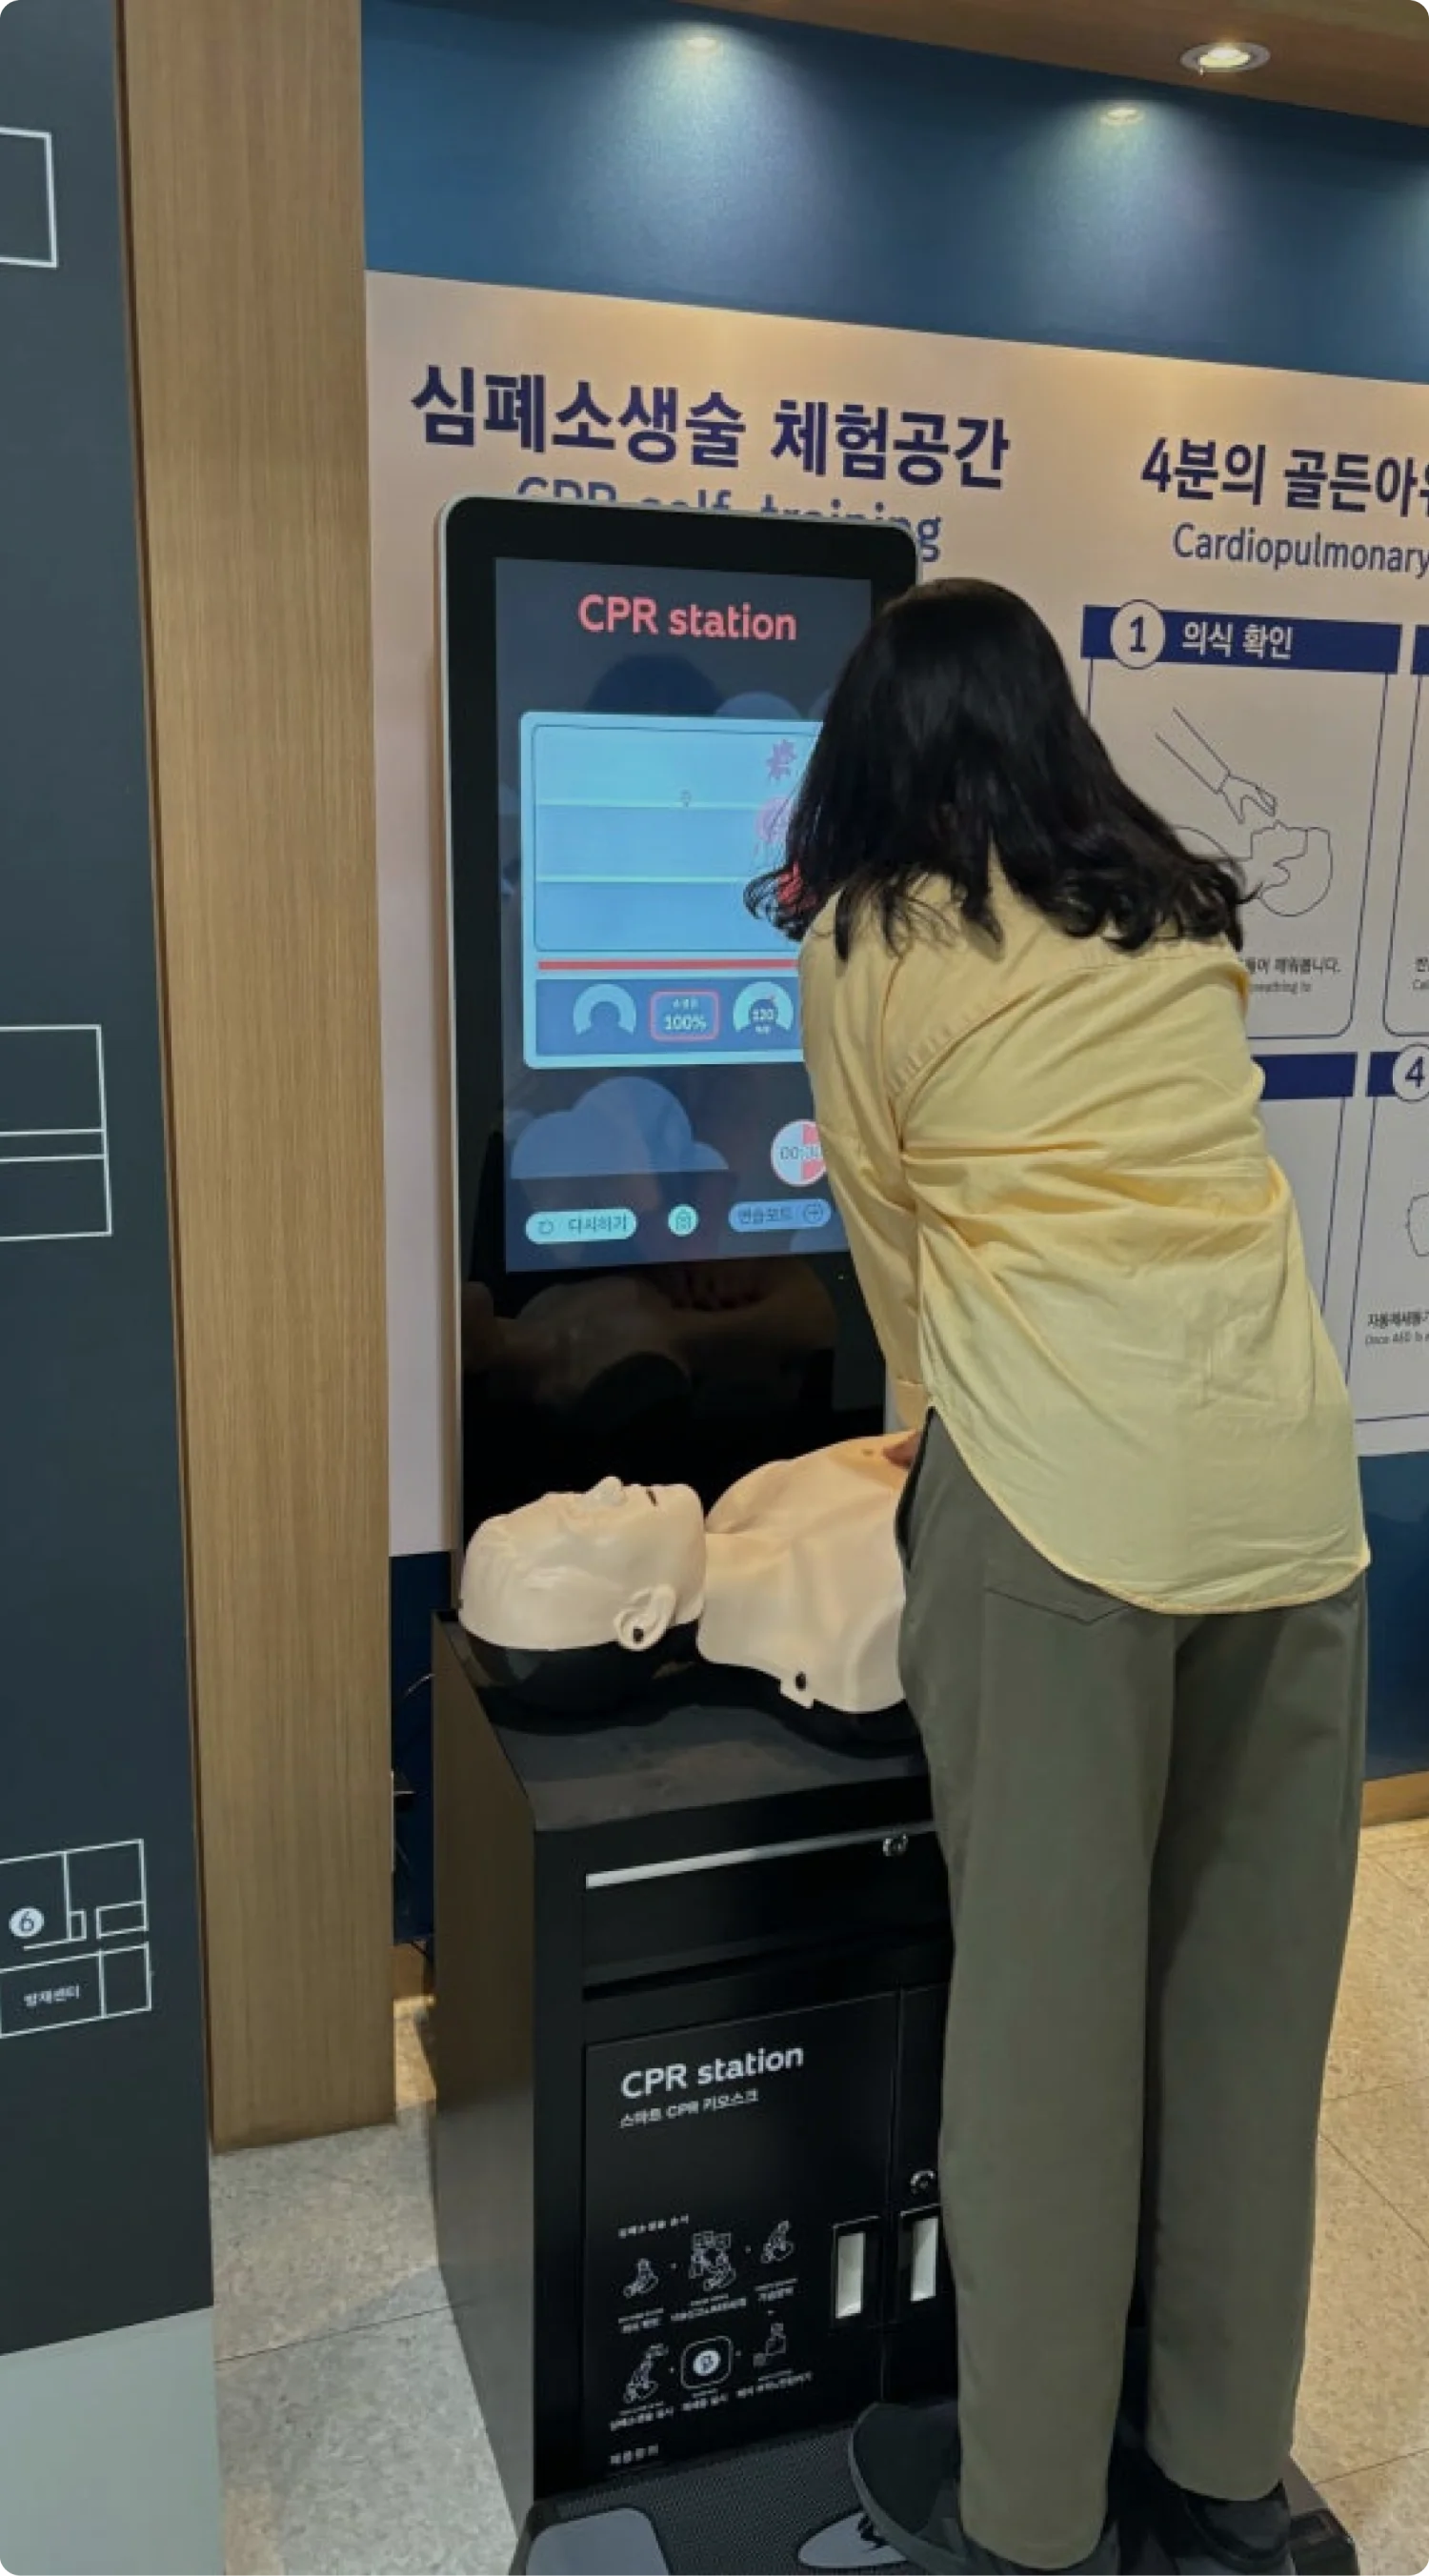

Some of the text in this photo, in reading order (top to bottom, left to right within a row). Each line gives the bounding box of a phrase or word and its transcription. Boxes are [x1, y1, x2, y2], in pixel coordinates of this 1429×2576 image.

[411, 365, 1011, 491] 심폐소생술 체험공간
[1140, 436, 1266, 506] 4분의
[1172, 521, 1429, 579] Cardiopulmonary
[577, 594, 797, 642] CPR station
[1129, 616, 1295, 660] 1 의식 확인
[663, 1013, 708, 1033] 100%
[1404, 1056, 1425, 1088] 4
[19, 1911, 34, 1932] 6
[621, 2047, 804, 2099] CPR station
